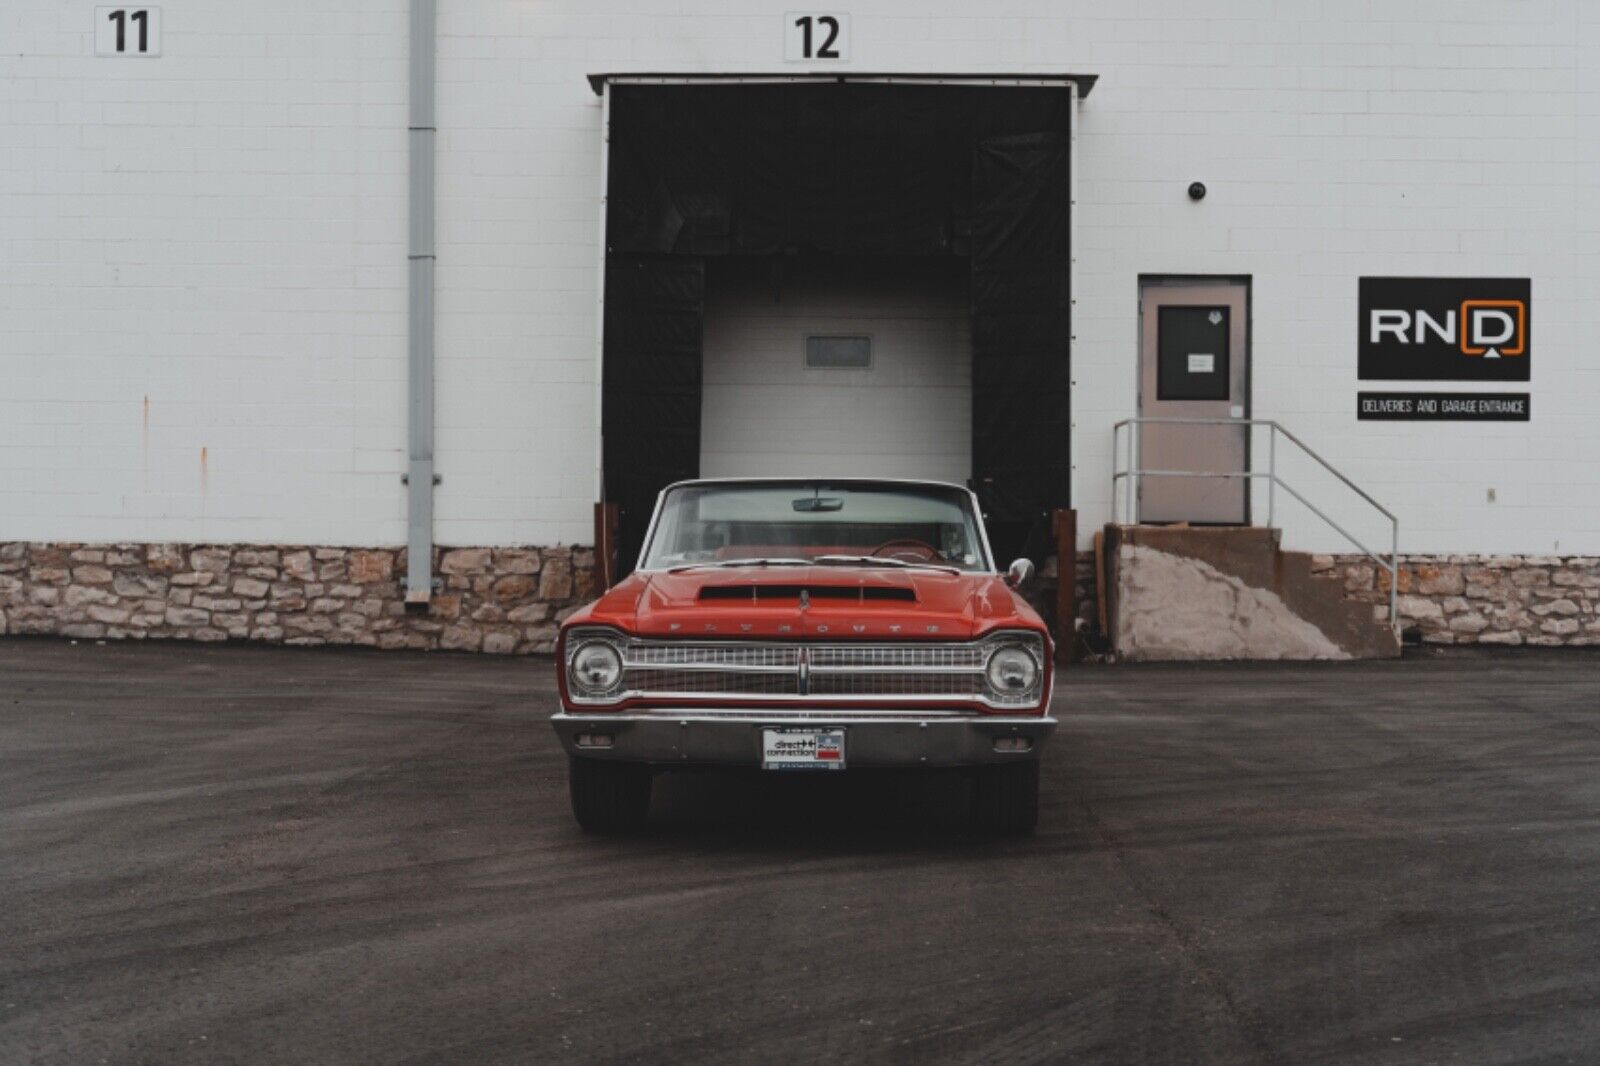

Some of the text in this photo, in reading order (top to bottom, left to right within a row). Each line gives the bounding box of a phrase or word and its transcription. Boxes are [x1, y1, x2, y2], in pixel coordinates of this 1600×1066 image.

[109, 10, 147, 52] 11
[795, 16, 839, 58] 12
[1370, 309, 1515, 345] RND
[1362, 399, 1524, 414] DELIVERIES AND GARAGE ENTRANCE
[774, 741, 800, 749] direct
